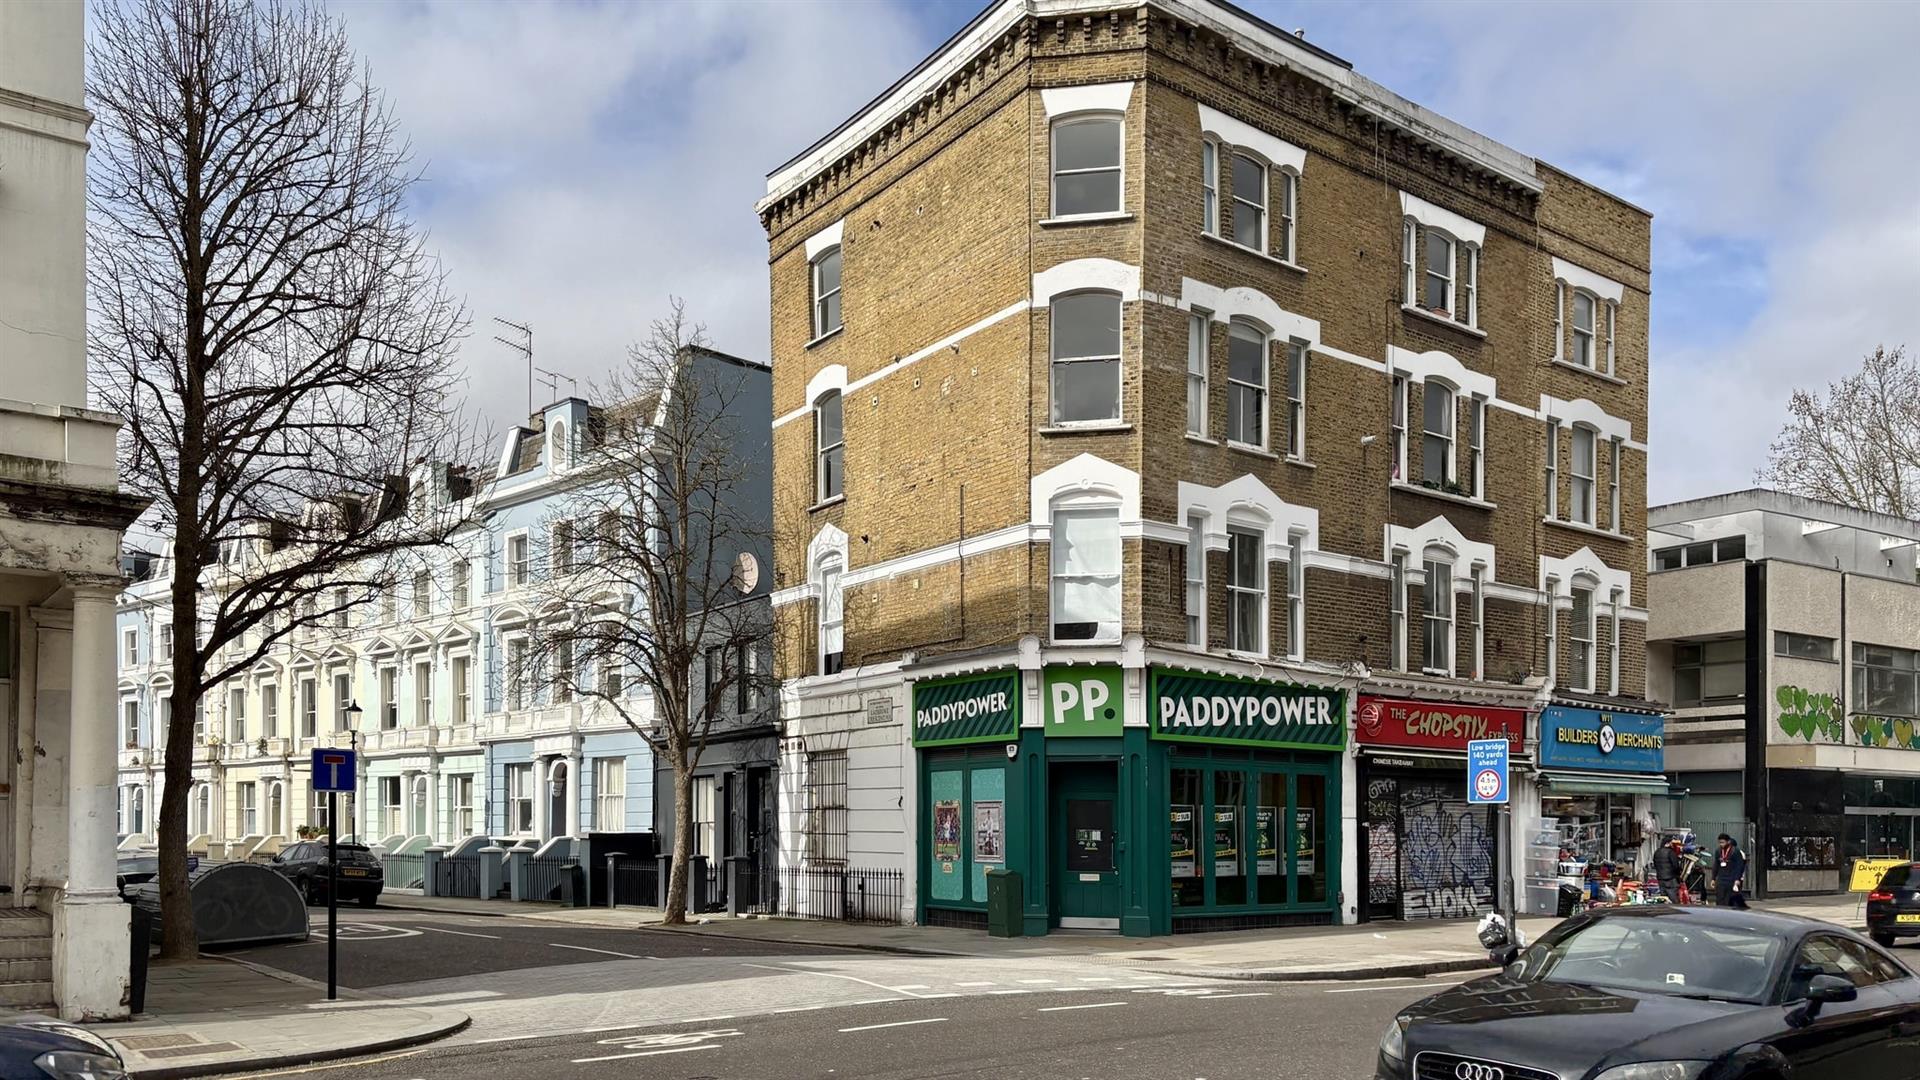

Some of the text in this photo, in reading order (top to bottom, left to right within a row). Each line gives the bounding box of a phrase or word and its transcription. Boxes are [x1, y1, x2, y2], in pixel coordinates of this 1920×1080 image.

[1601, 714, 1613, 722] W11
[1390, 707, 1488, 738] THE CHOPSTIX
[1558, 727, 1662, 749] BUILDERS MERCHANTS
[1485, 744, 1505, 752] bridge
[1486, 752, 1504, 760] yards
